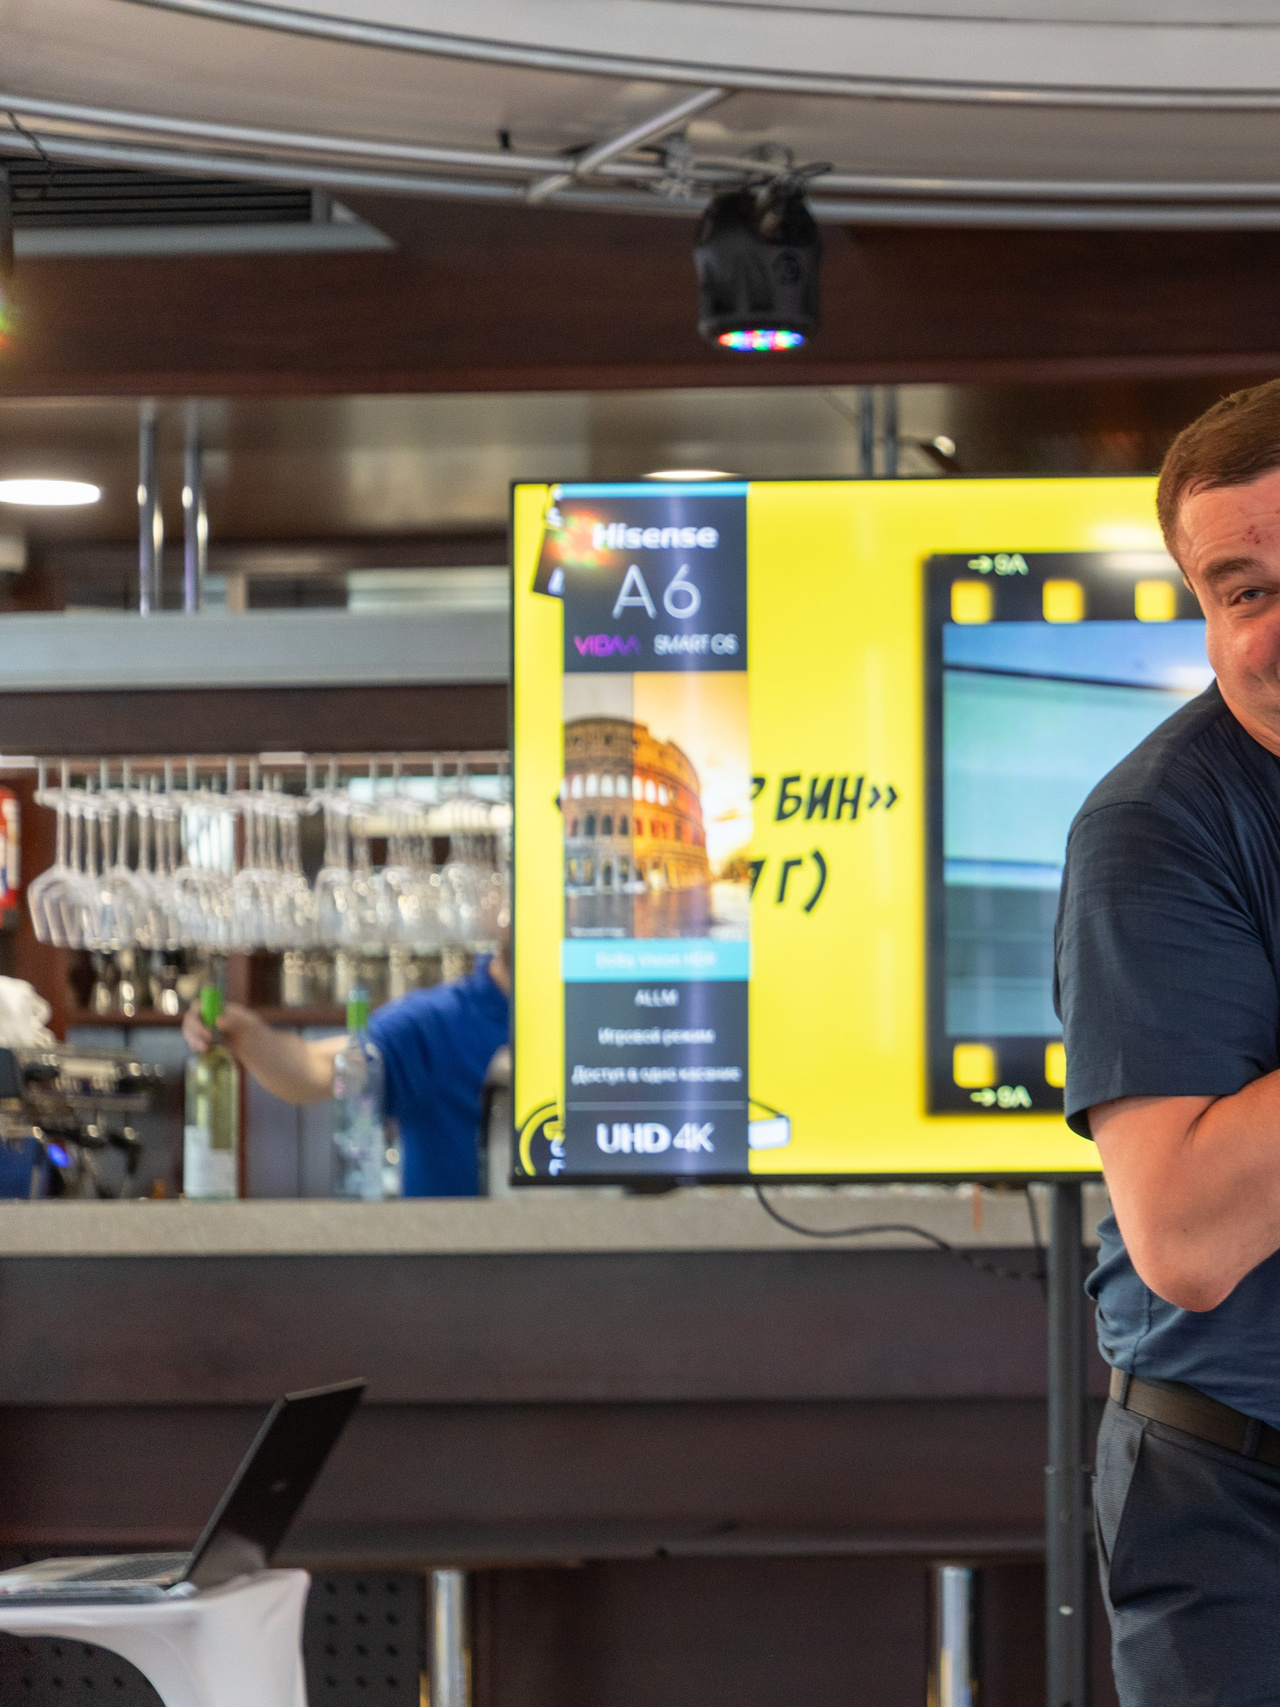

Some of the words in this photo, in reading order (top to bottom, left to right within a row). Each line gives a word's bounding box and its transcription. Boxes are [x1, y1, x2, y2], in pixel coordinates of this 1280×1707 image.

[592, 522, 719, 550] Hisense
[652, 632, 710, 656] SMART
[711, 632, 740, 656] OS
[634, 988, 679, 1007] ALLM
[596, 1122, 671, 1154] UHD
[672, 1121, 716, 1153] 4K
